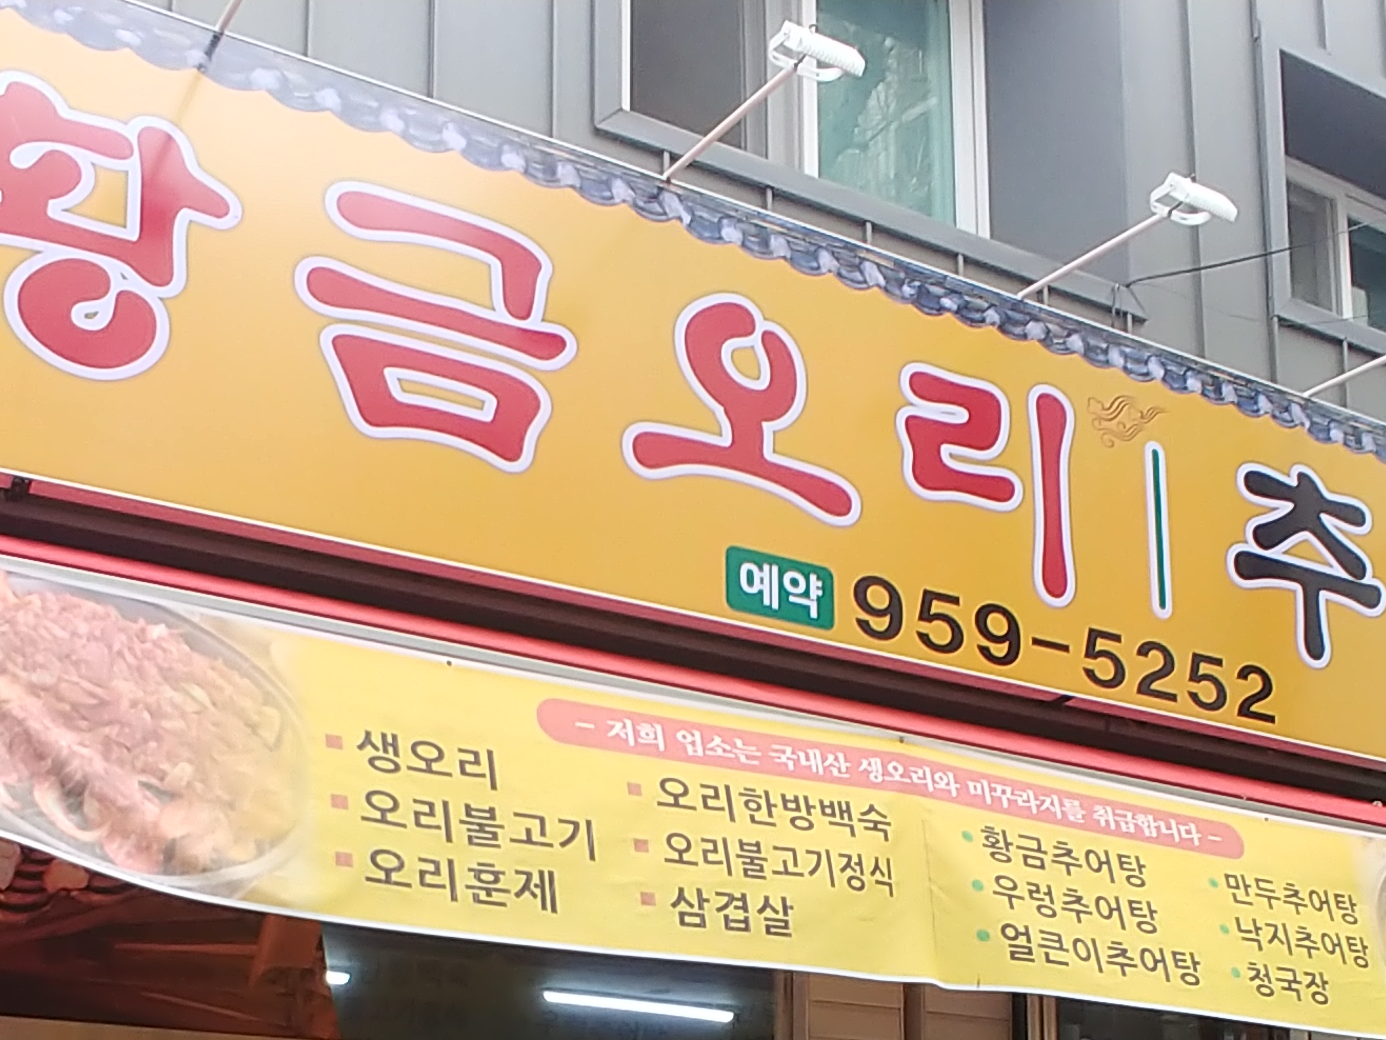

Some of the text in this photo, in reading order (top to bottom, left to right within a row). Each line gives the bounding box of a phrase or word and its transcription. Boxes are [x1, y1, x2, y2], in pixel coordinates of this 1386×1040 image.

[738, 553, 1278, 723] 예약 959-5252
[356, 730, 498, 791] 생오리
[606, 718, 1203, 847] 저희 업소는 국내산 생오리와 미꾸라지를 취급합니다
[360, 789, 596, 862] 오리불고기
[657, 777, 892, 842] 오리한방백숙
[364, 848, 558, 914] 오리훈제
[664, 832, 895, 898] 오리불고기정식
[981, 824, 1147, 888] 황금추어탕
[670, 886, 794, 938] 삼겹살
[992, 873, 1159, 935] 우렁추어탕
[1223, 872, 1359, 926] 만두추어탕
[999, 921, 1202, 987] 얼큰이추어탕
[1234, 916, 1371, 969] 낙지추어탕
[1247, 961, 1331, 1006] 청국장
